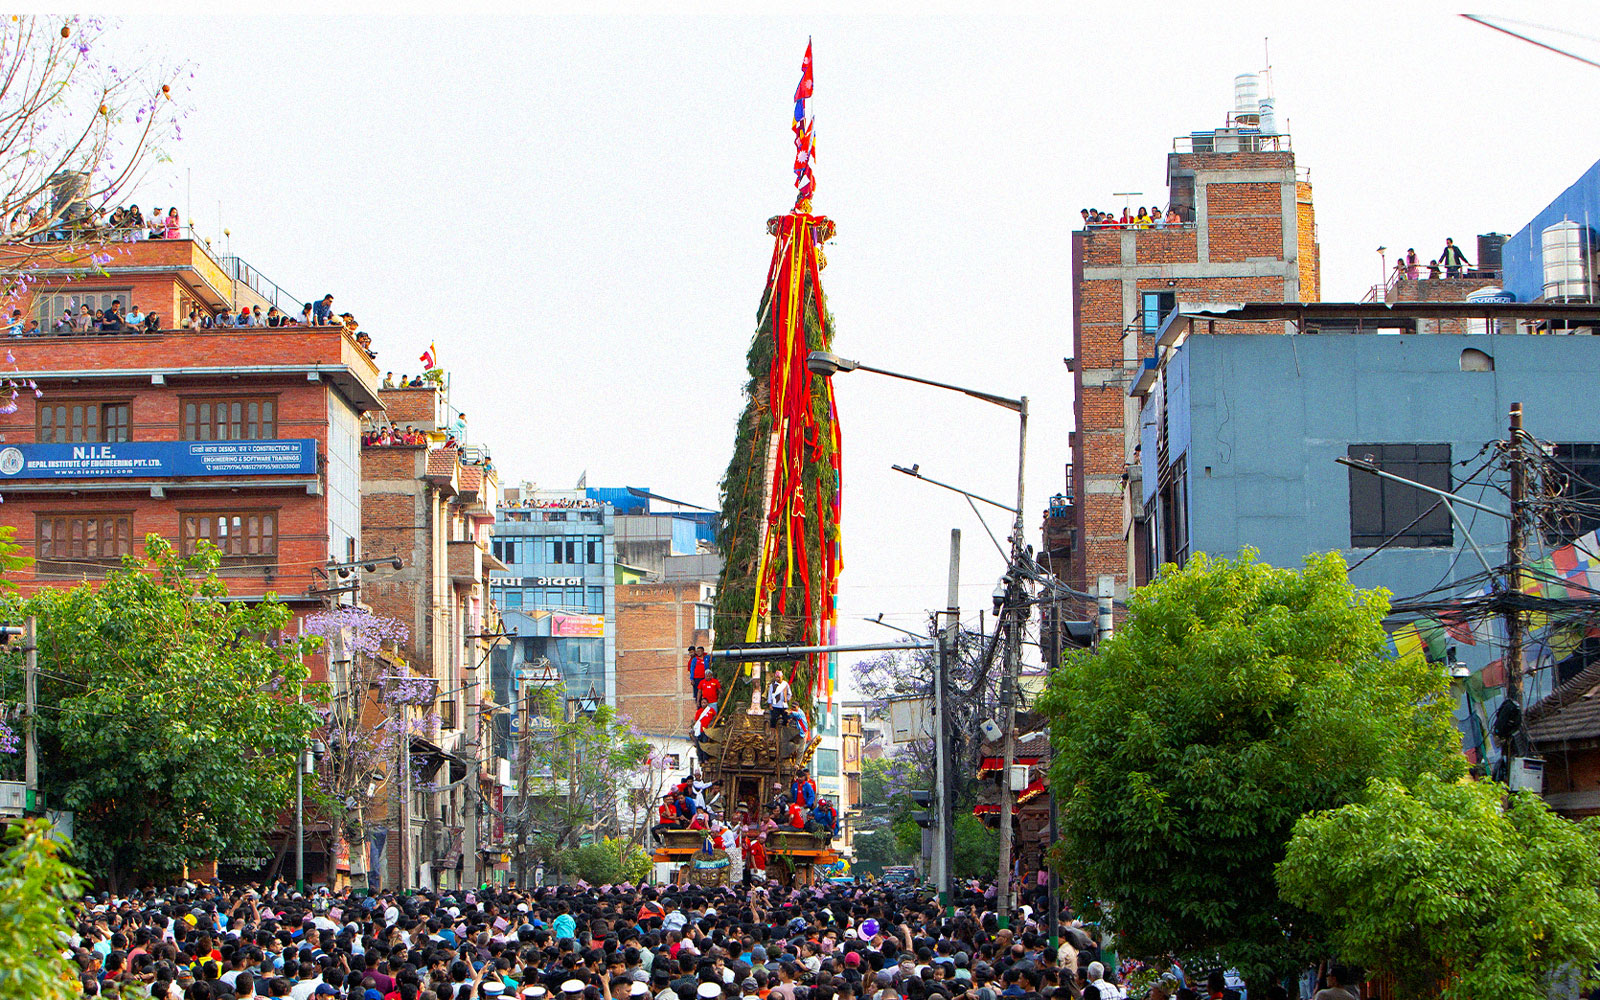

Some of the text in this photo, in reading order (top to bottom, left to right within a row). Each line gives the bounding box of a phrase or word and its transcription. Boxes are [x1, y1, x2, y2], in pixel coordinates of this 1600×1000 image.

[73, 446, 117, 459] N.I.E.
[27, 460, 47, 468] NEPAL
[48, 460, 80, 468] INSTITUTE
[91, 459, 133, 467] ENGINEERING
[134, 459, 148, 467] PVT.
[148, 459, 162, 467] LTD.
[537, 576, 583, 586] भवन
